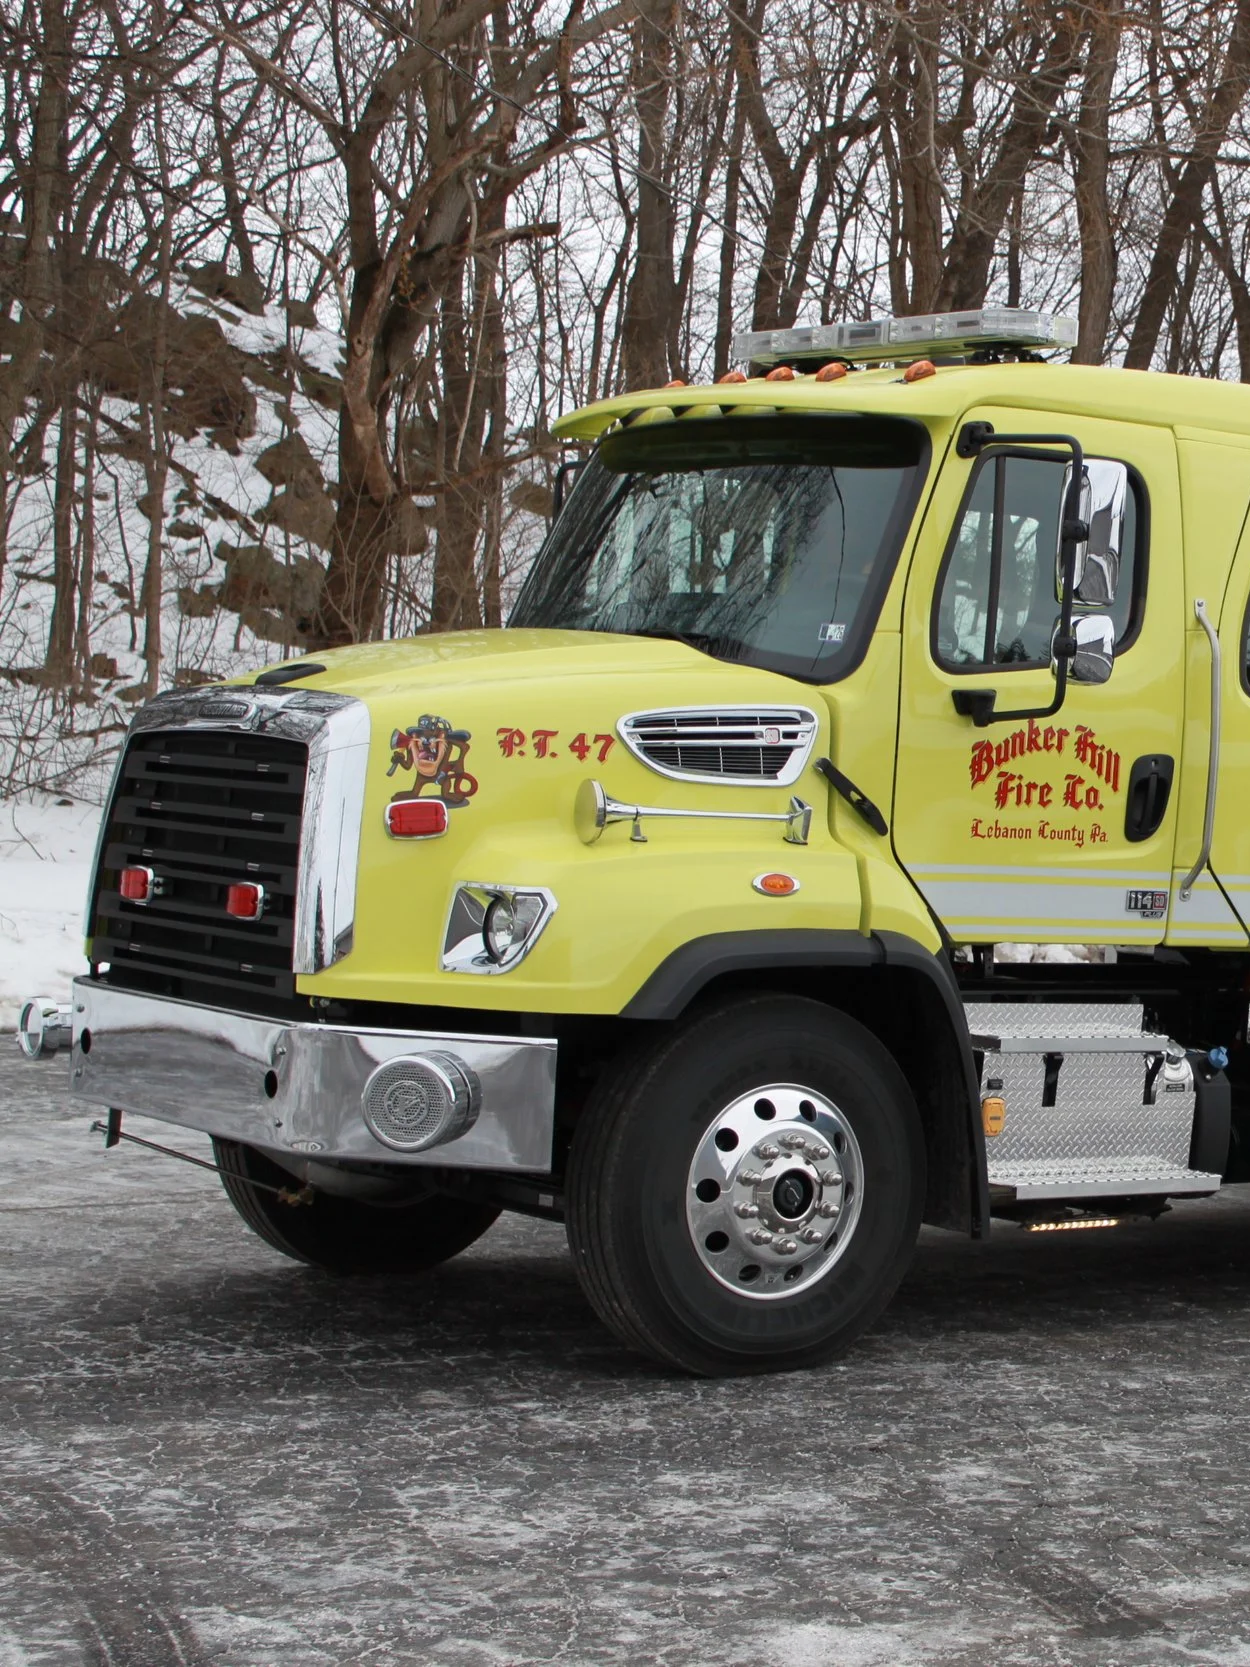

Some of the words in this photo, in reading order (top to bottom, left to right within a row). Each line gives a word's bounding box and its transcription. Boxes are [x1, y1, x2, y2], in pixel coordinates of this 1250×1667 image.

[568, 732, 617, 764] 47
[969, 718, 1070, 791] Bunker
[1074, 724, 1121, 793] Hill
[994, 771, 1053, 811] Fire
[1063, 774, 1104, 812] Co.
[970, 818, 1032, 840] Lebanon
[1038, 820, 1085, 848] County
[1130, 891, 1153, 909] 114
